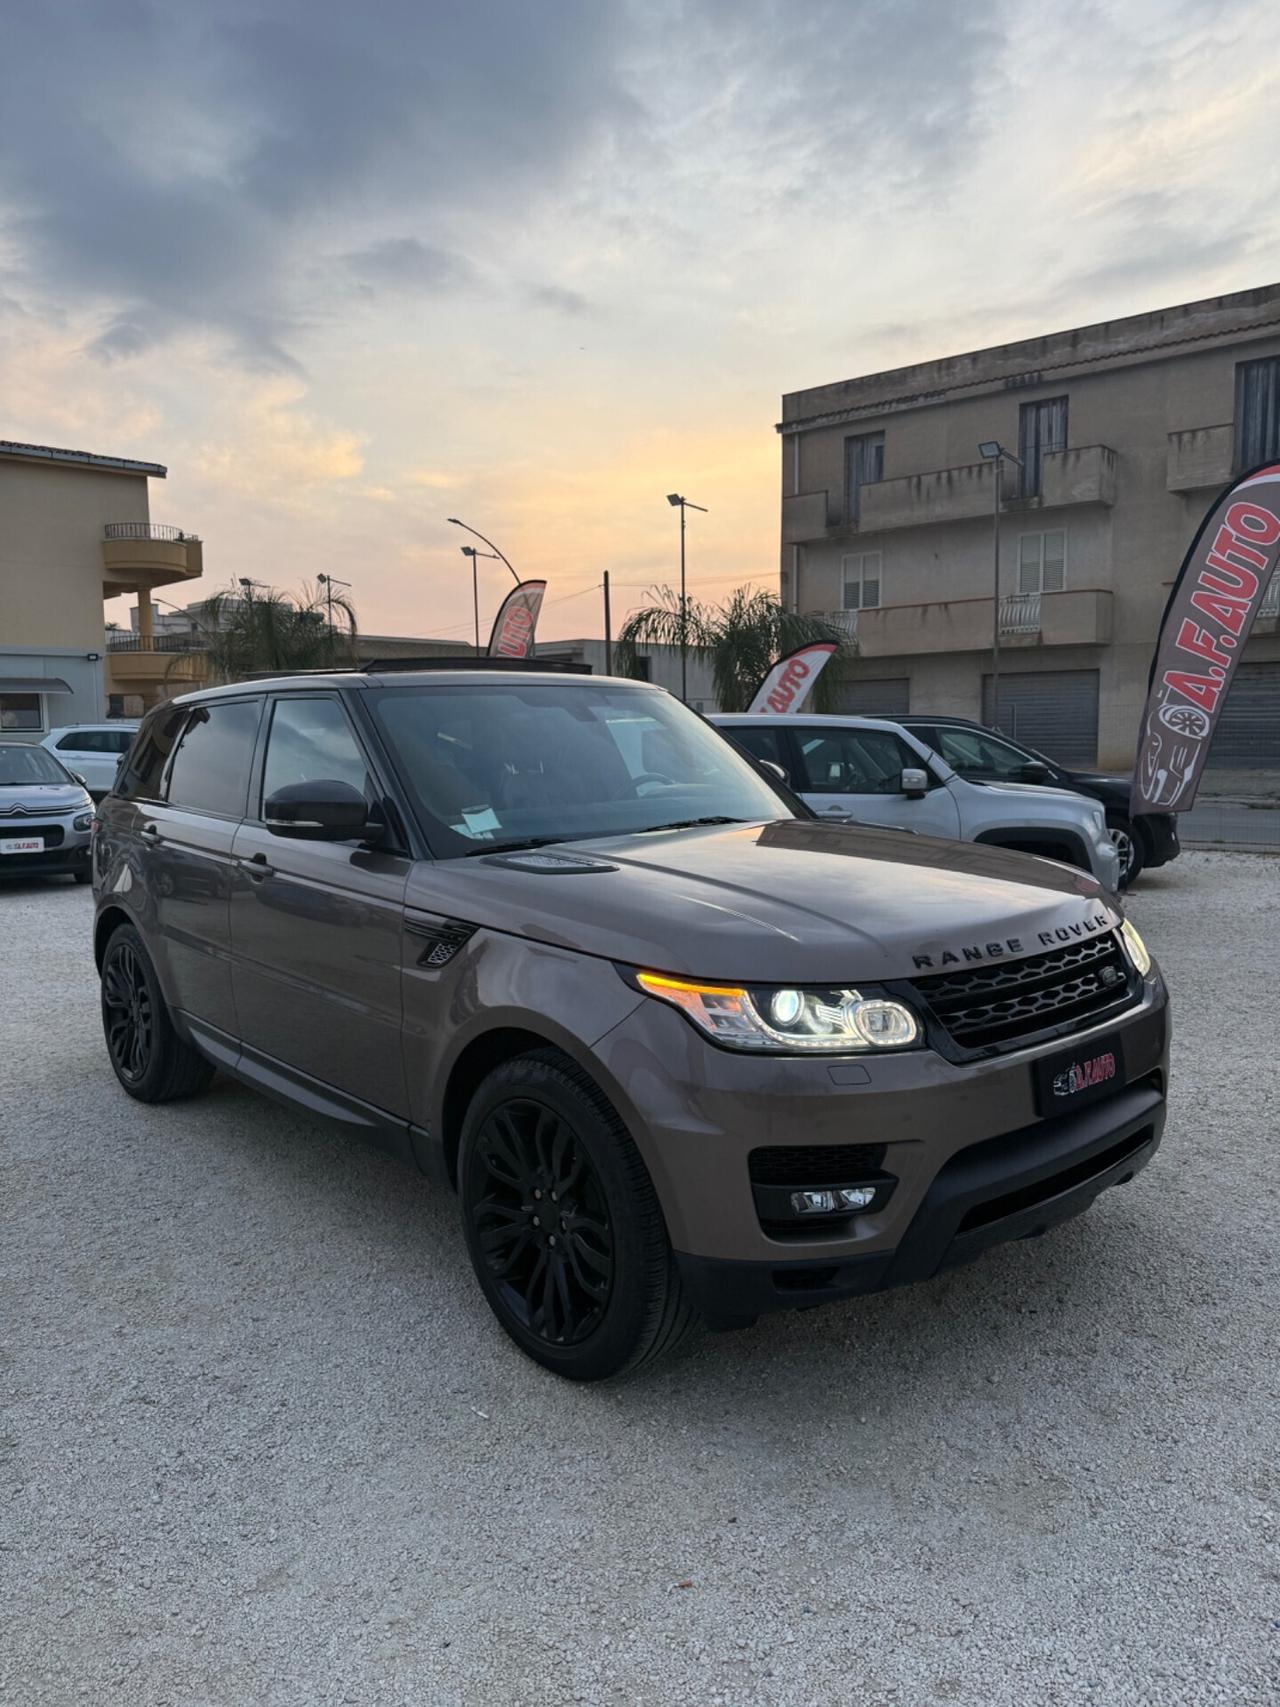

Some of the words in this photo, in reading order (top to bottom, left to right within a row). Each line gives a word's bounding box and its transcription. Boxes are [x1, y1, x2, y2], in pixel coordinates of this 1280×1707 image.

[498, 605, 533, 657] UTO
[1163, 501, 1280, 714] A.F.AUTO
[761, 658, 811, 713] AUTO
[912, 938, 1025, 969] RANGE
[1037, 914, 1108, 947] ROVER
